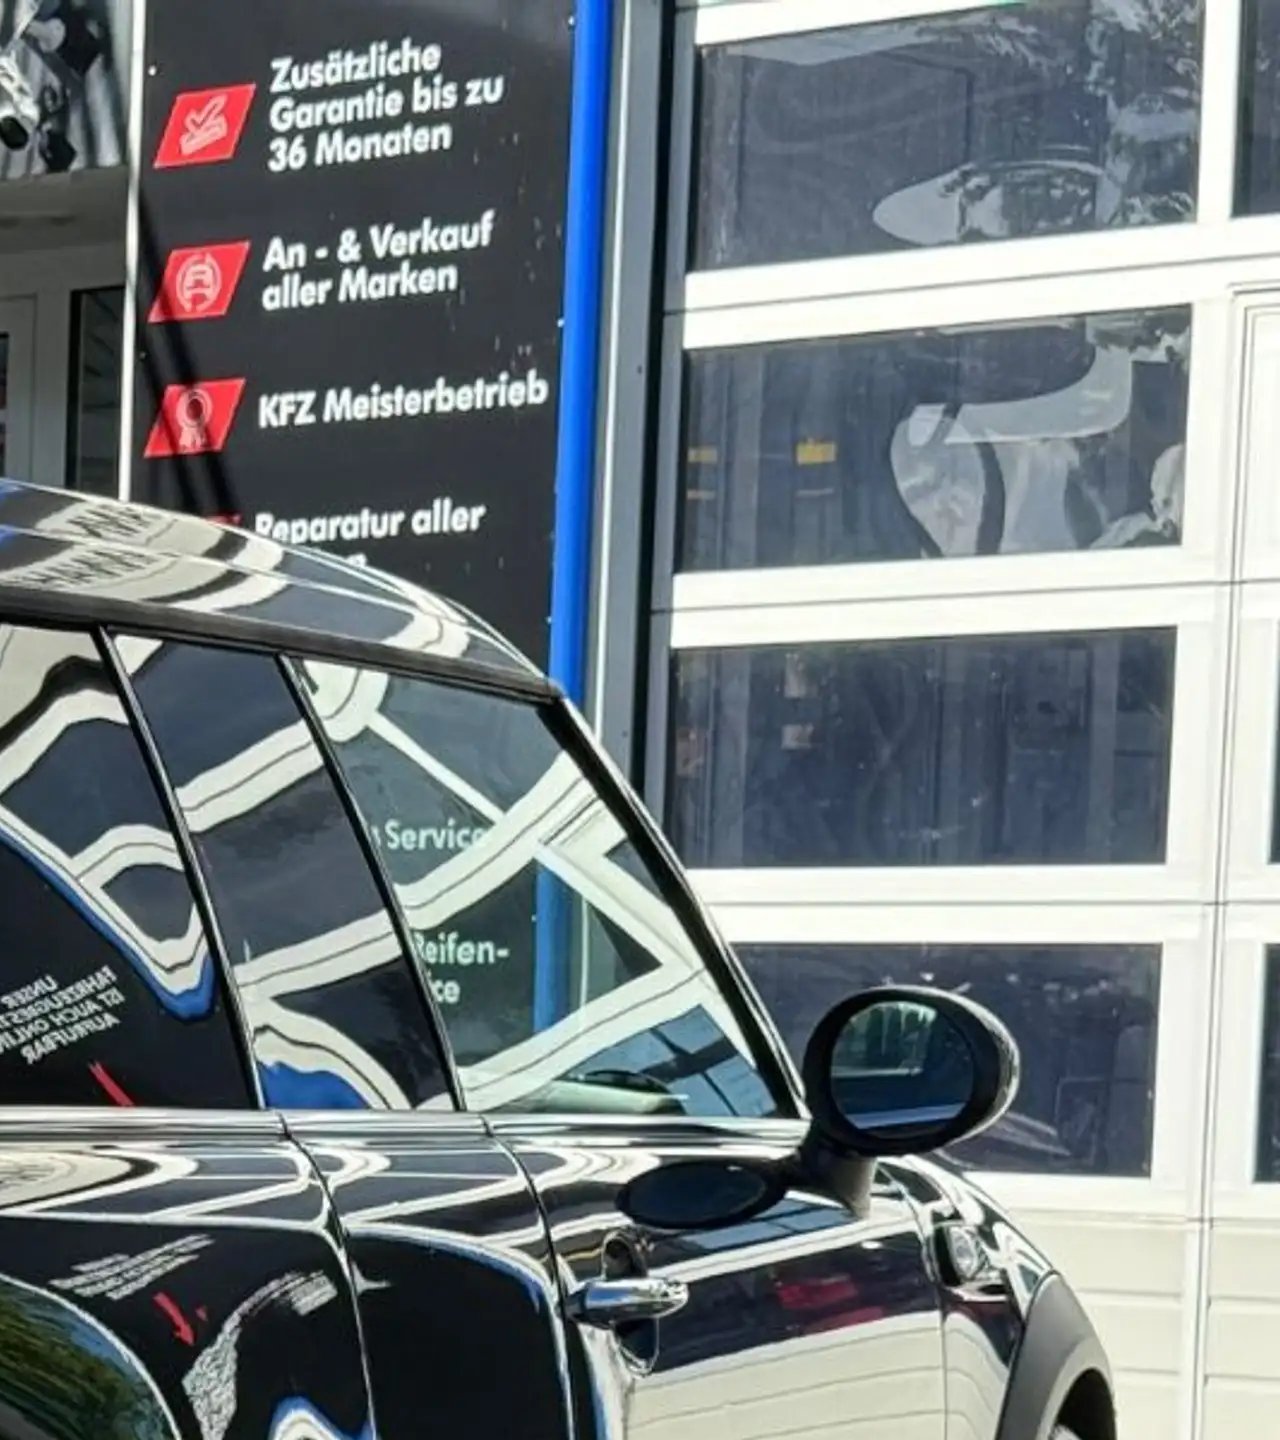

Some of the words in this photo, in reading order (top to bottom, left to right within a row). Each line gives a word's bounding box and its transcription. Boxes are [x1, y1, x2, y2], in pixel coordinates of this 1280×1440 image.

[270, 37, 441, 93] Zusätzliche
[270, 83, 403, 132] Garantie
[412, 73, 458, 113] bis
[465, 75, 504, 106] zu
[268, 134, 307, 172] 36
[315, 122, 452, 166] Monaten
[262, 236, 307, 272] An
[337, 229, 362, 263] &
[369, 209, 495, 258] Verkauf
[262, 273, 333, 310] aller
[338, 260, 458, 302] Marken
[259, 391, 316, 428] KFZ
[323, 369, 549, 423] Meisterbetrieb
[411, 496, 487, 536] aller
